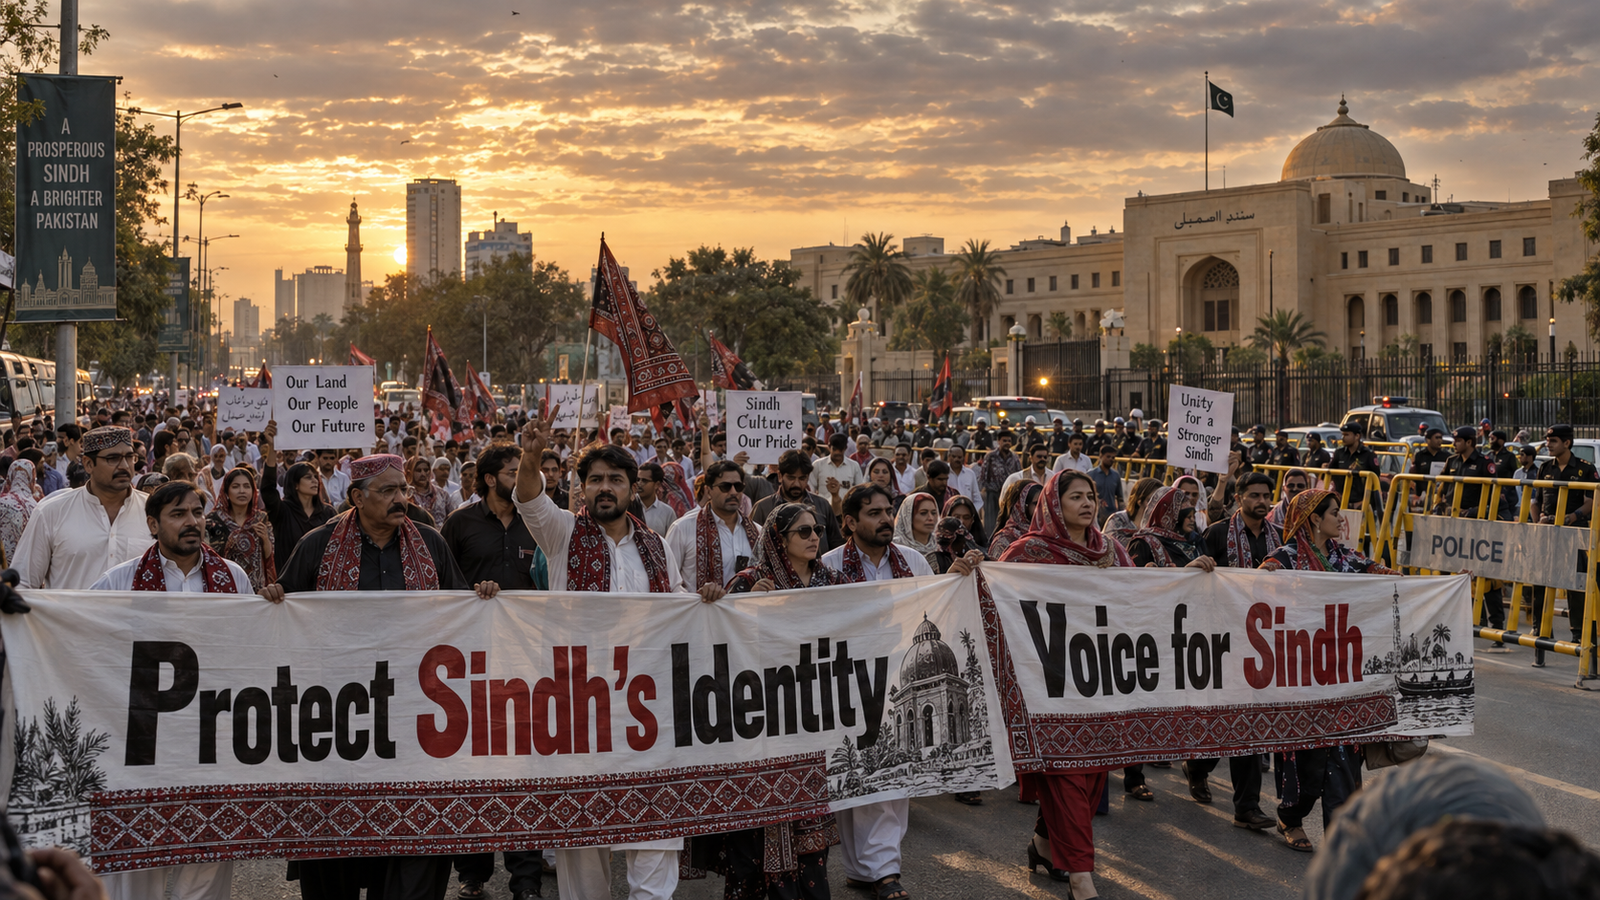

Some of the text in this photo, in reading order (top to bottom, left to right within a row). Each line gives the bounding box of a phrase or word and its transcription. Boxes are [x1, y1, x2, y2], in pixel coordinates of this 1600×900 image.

[61, 117, 71, 135] A
[27, 141, 105, 158] PROSPEROUS
[43, 163, 90, 183] SINDH
[30, 190, 103, 207] A BRIGHTER
[36, 212, 98, 229] PAKISTAN
[286, 374, 347, 389] Our Land
[287, 397, 311, 411] Our
[317, 396, 359, 413] People
[745, 395, 780, 411] Sindh
[1181, 393, 1213, 412] Unity
[291, 418, 366, 433] Our Future
[736, 413, 794, 430] Culture
[1185, 410, 1214, 427] for a
[737, 433, 797, 449] Our Pride
[1177, 427, 1221, 447] Stronger
[1185, 445, 1213, 461] Sindh
[1431, 534, 1504, 564] POLICE
[1019, 600, 1364, 698] Voice for Sindh
[124, 637, 889, 767] Protect Sindh's Identity
